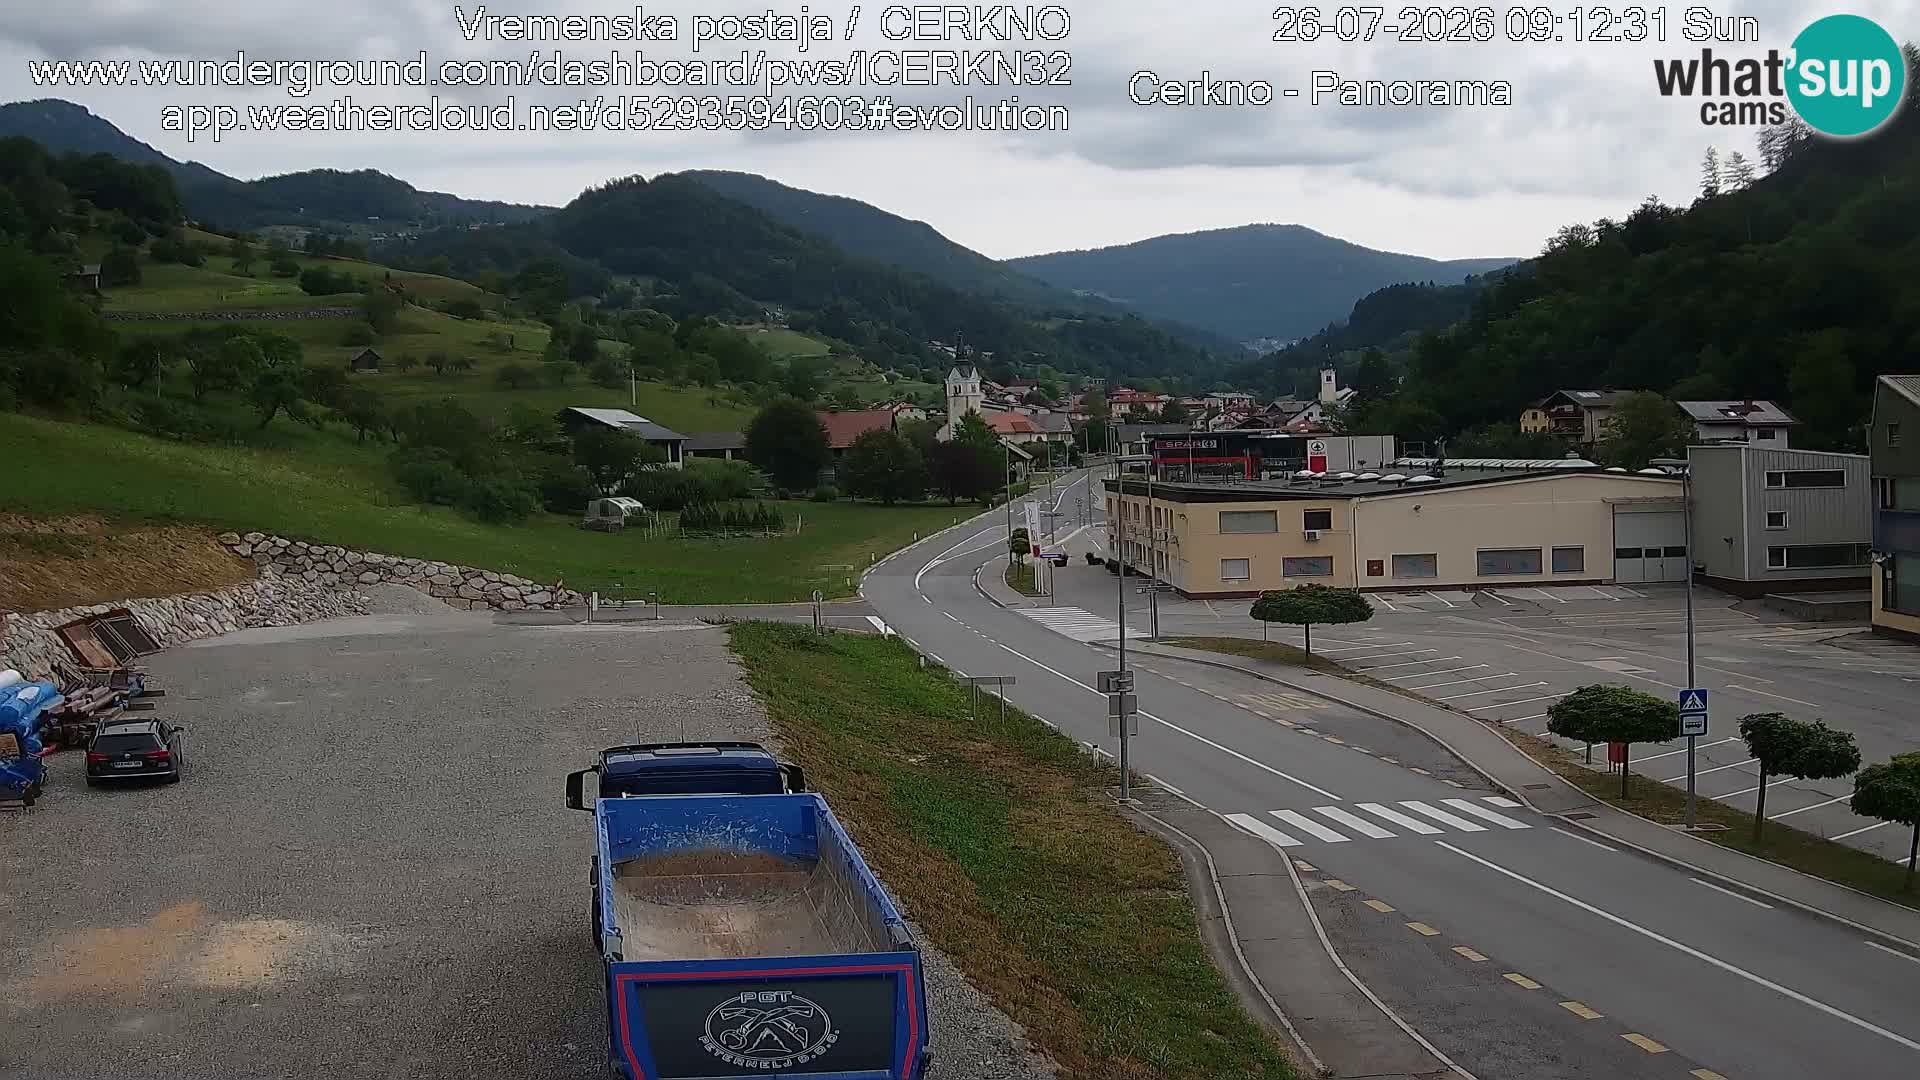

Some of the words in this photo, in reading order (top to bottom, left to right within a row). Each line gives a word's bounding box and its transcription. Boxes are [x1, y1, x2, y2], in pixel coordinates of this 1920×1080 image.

[1165, 440, 1201, 448] SPAR
[740, 990, 793, 1003] PGT
[698, 1035, 793, 1069] PETERNELJ
